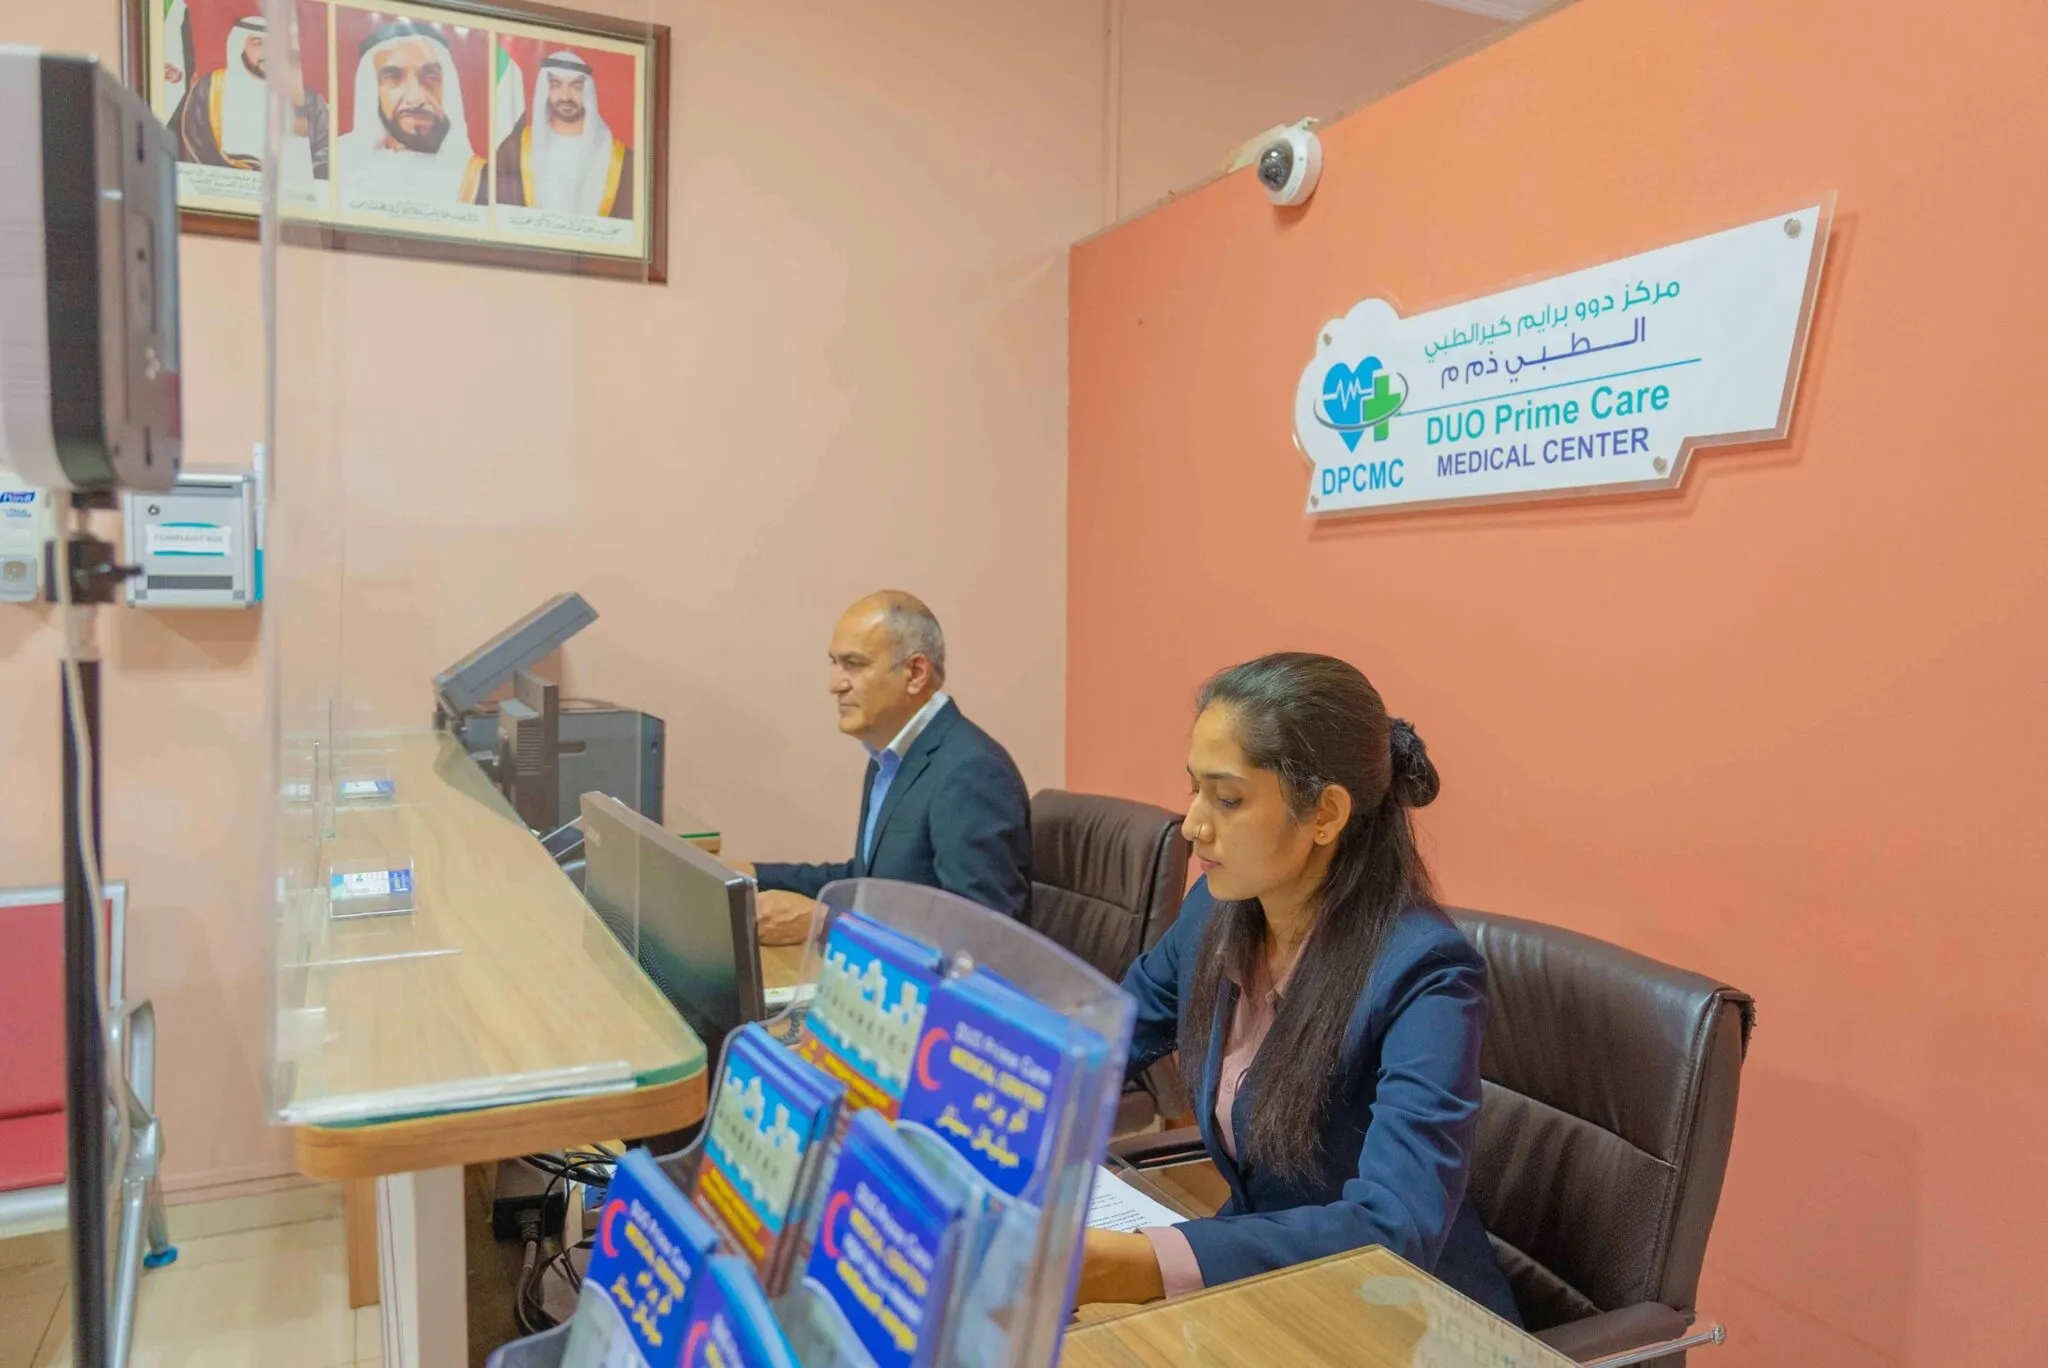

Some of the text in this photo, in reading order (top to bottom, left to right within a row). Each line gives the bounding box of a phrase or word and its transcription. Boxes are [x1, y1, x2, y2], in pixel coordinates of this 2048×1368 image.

[1575, 294, 1615, 320] دوو
[1622, 280, 1680, 312] مركز
[1517, 304, 1568, 336] برايم
[1427, 384, 1670, 446] DUO Prime Care
[1437, 426, 1649, 478] MEDICAL CENTER
[1322, 458, 1405, 496] DPCMC
